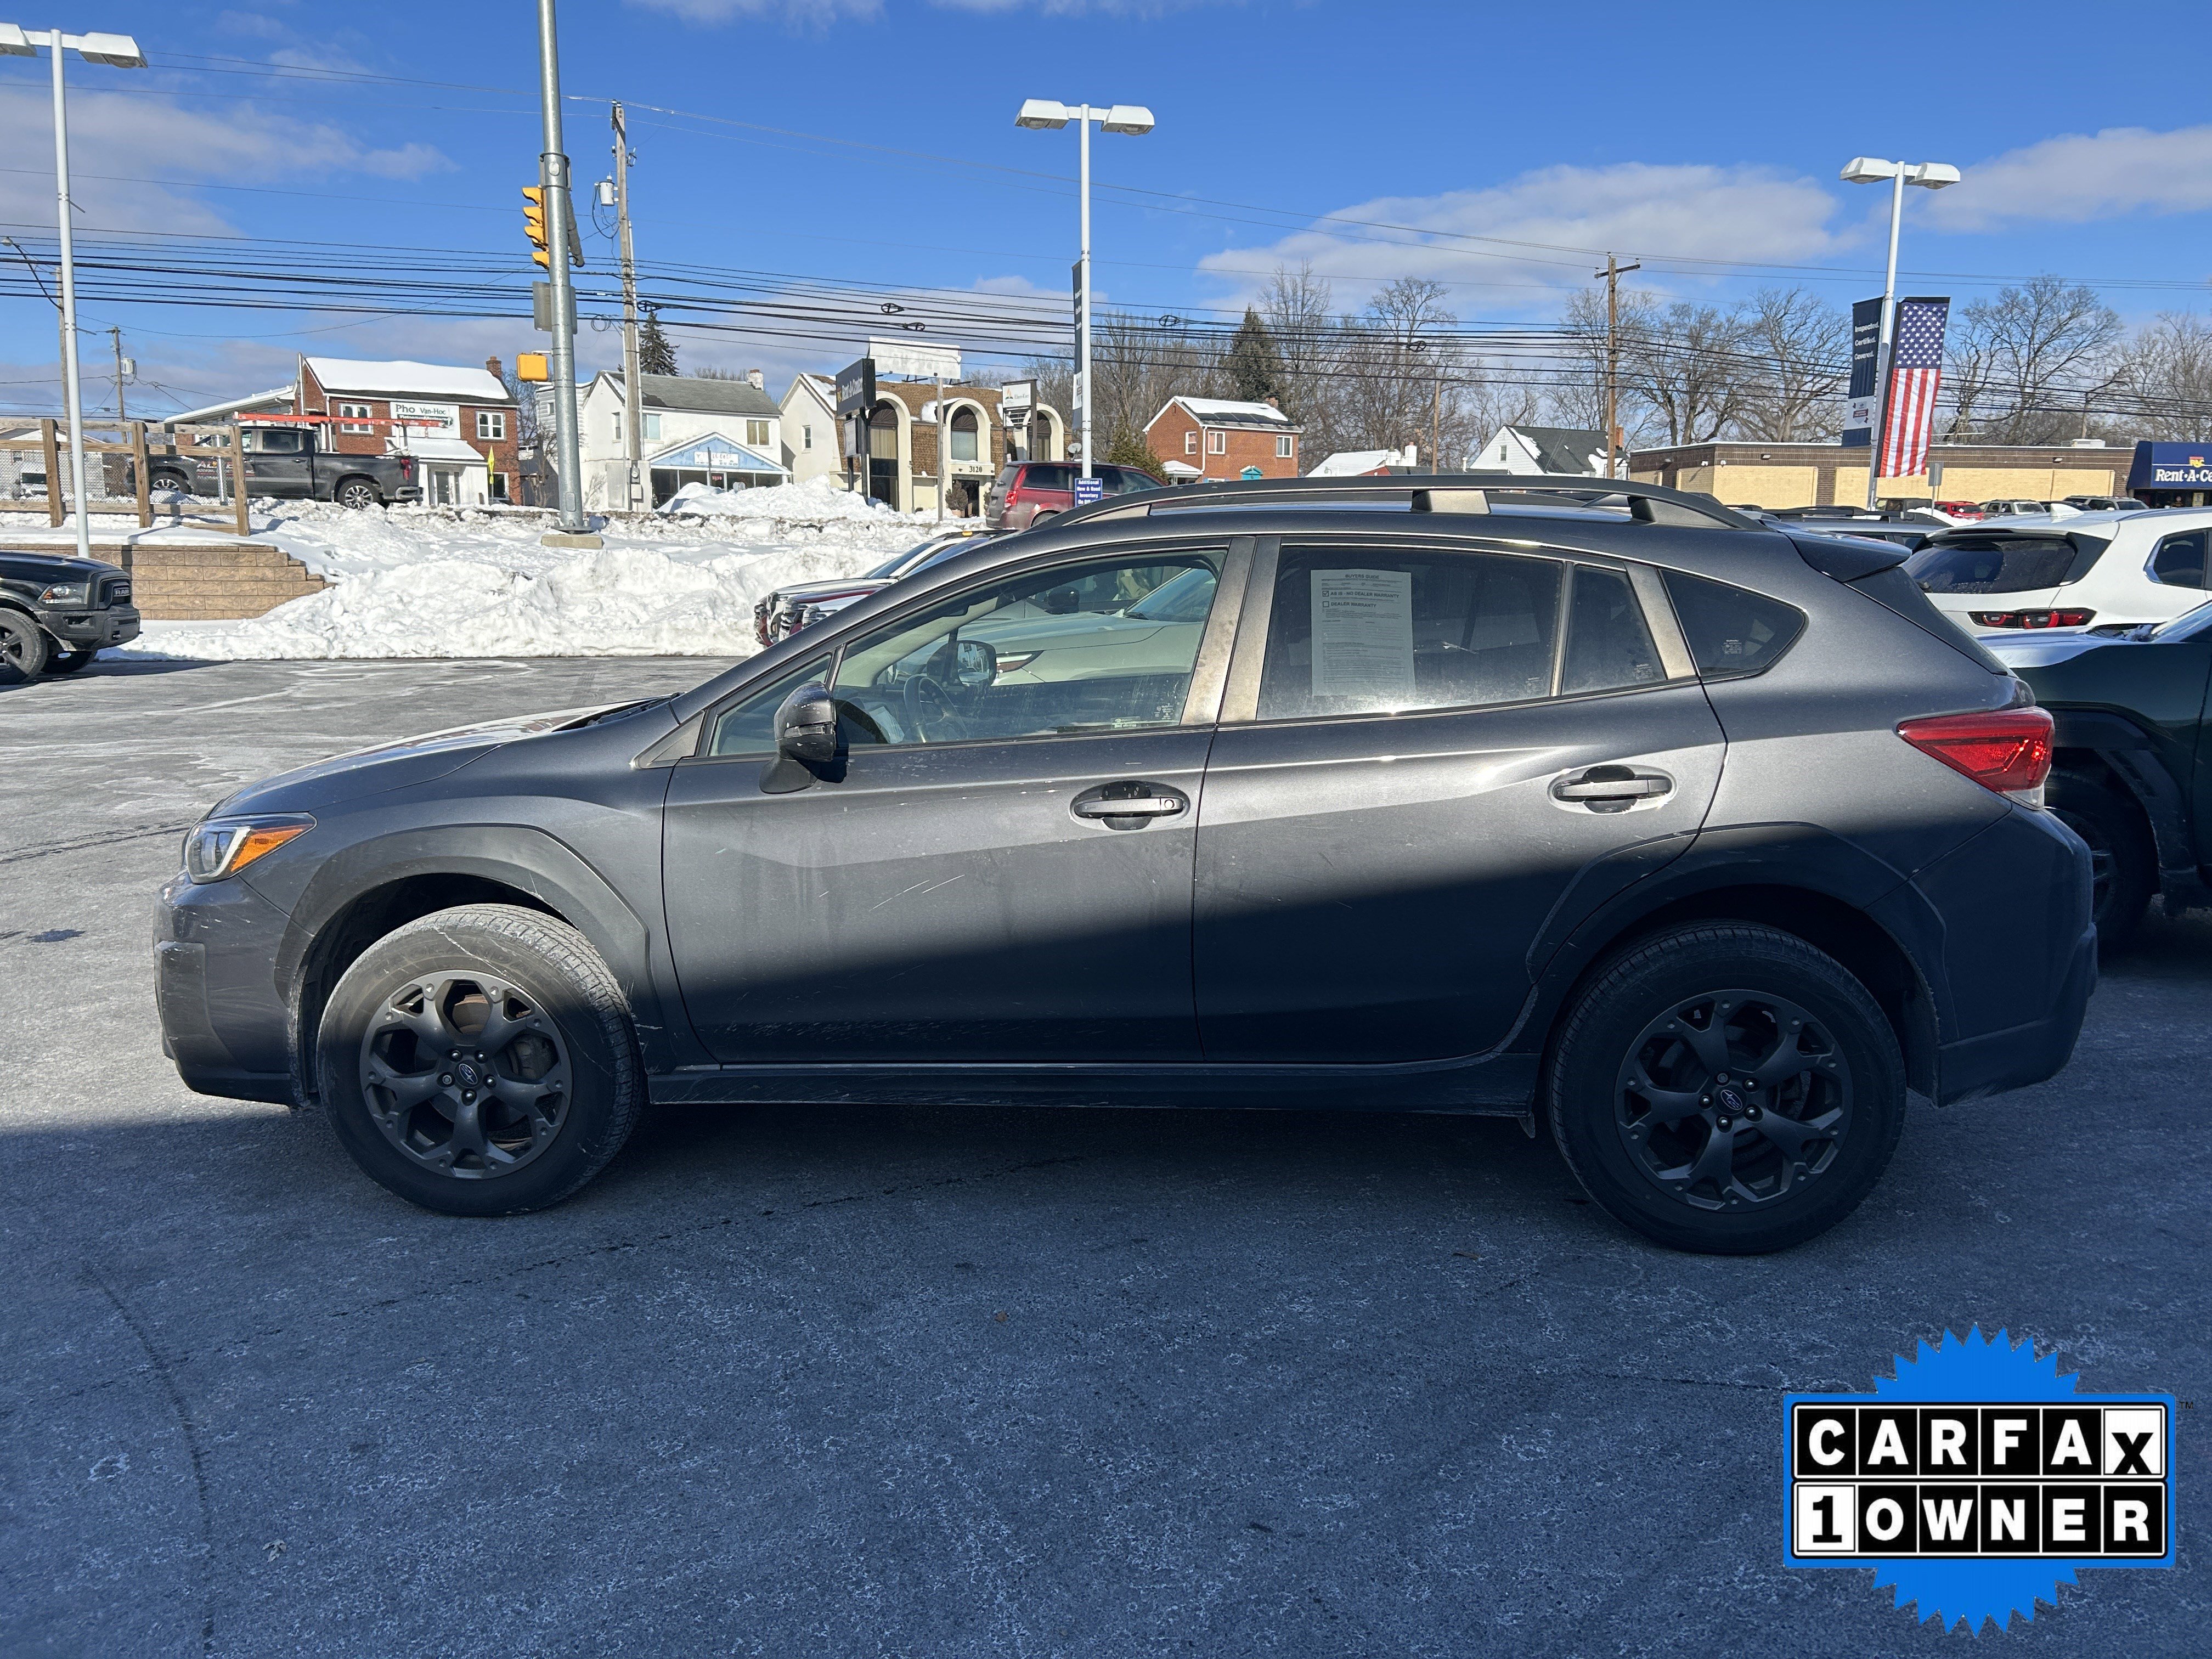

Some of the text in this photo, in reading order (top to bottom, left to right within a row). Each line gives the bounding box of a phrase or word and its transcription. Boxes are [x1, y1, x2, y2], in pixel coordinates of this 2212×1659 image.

[1855, 321, 1880, 332] Inspected.
[1855, 351, 1874, 360] Covered.
[396, 404, 416, 413] Pho
